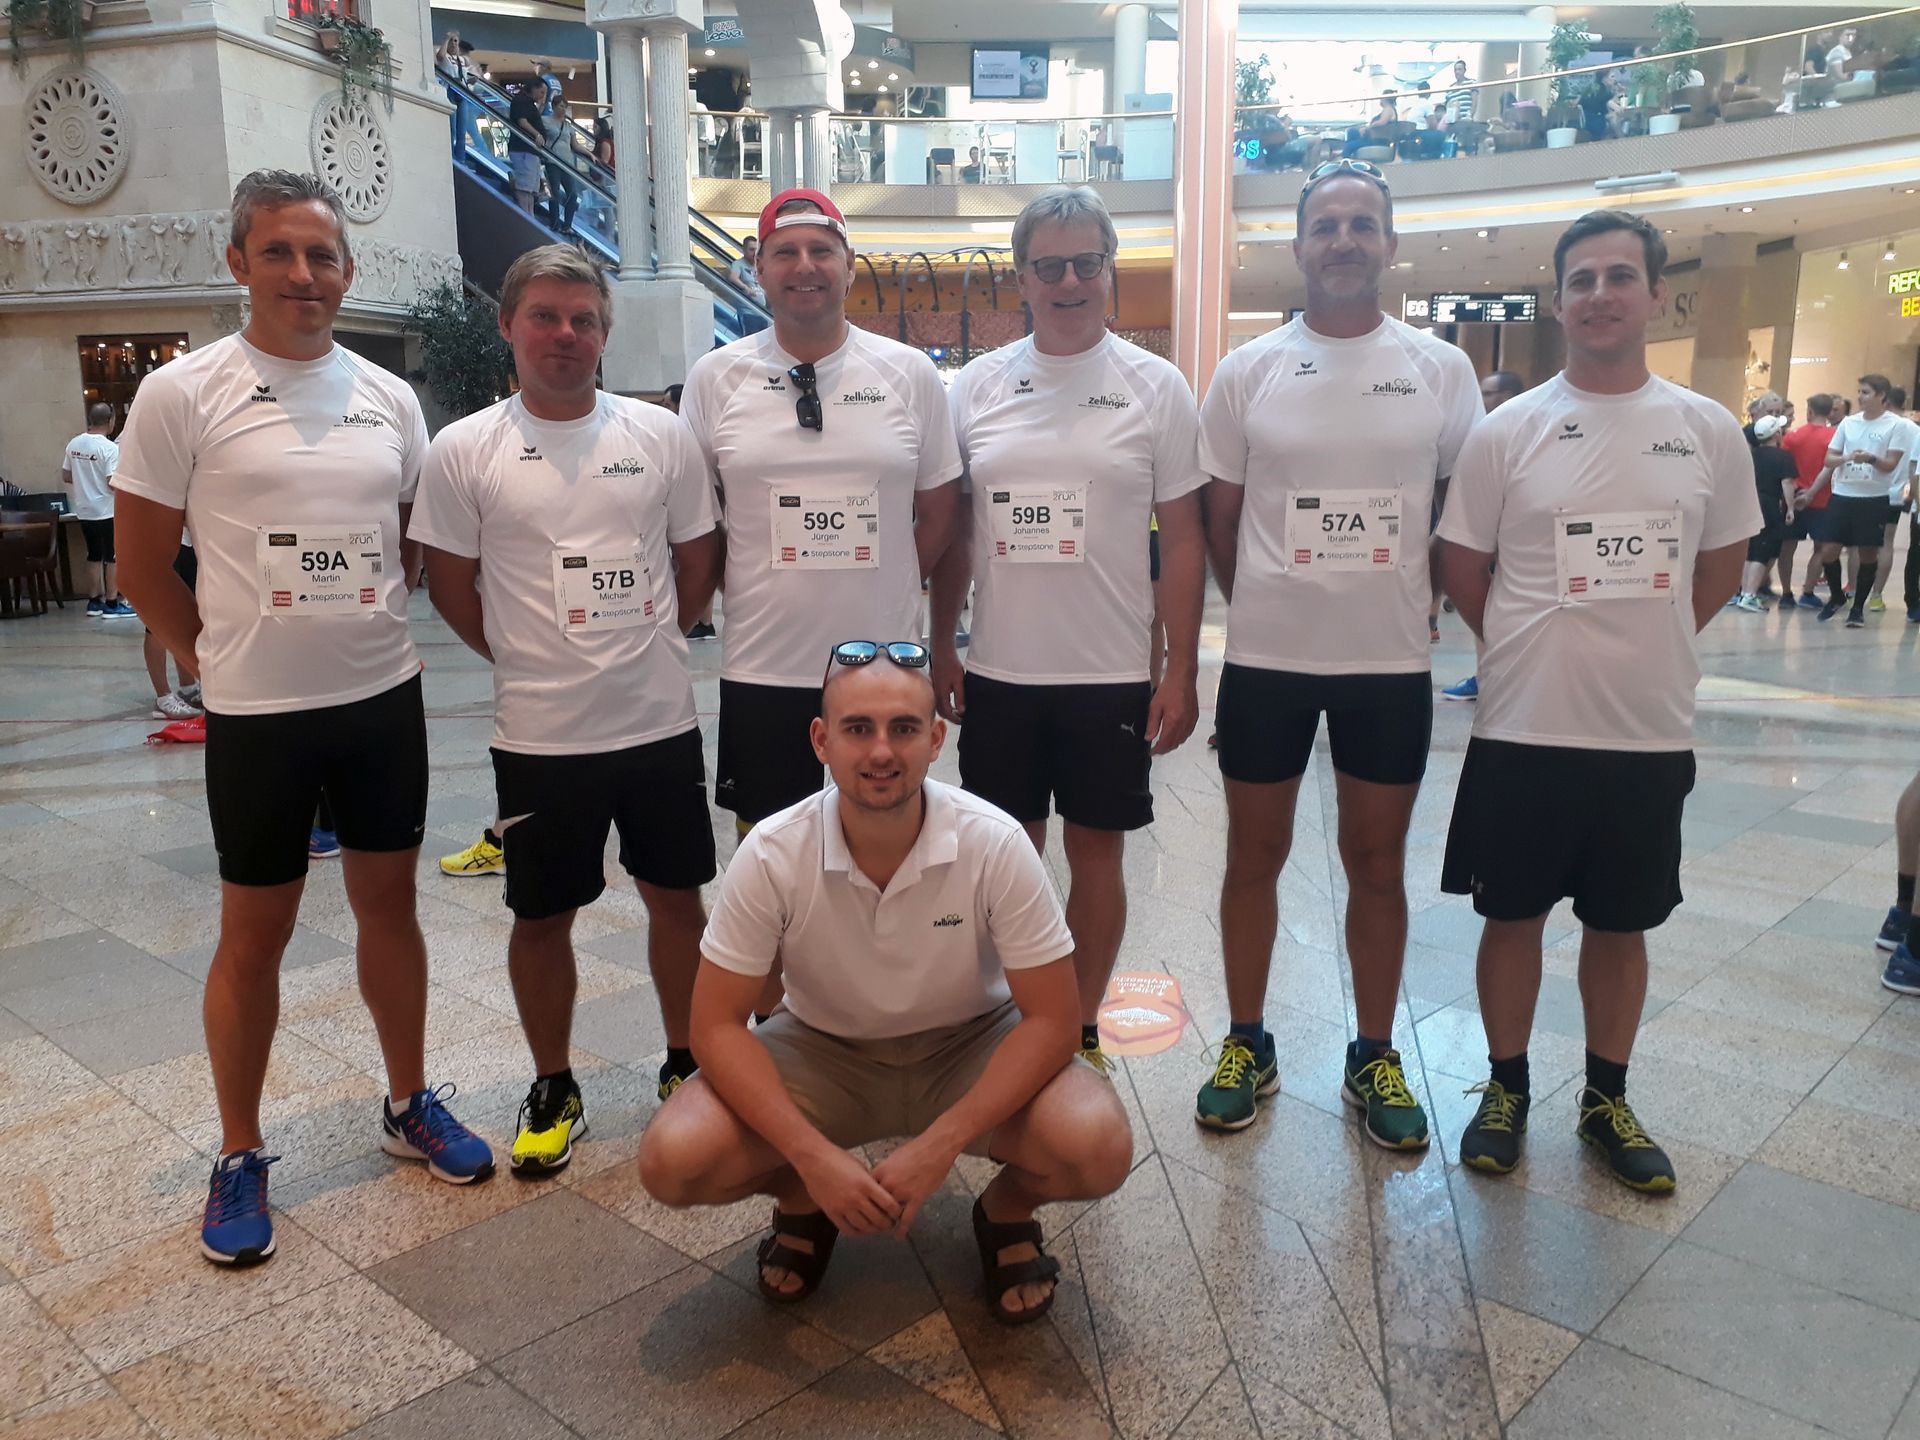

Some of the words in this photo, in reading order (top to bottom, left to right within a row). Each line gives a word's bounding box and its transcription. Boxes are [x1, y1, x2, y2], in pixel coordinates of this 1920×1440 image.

[1372, 382, 1417, 395] Zellinger
[843, 392, 886, 403] Zellinger
[1088, 395, 1131, 409] Zellinger
[342, 413, 384, 427] Zellinger
[1652, 441, 1696, 457] Zellinger
[602, 462, 644, 475] Zellinger
[804, 511, 845, 530] 59C
[1012, 506, 1051, 524] 59B
[1322, 513, 1366, 532] 57A
[811, 533, 840, 542] Jürgen
[1013, 527, 1050, 535] Johannes
[1327, 535, 1360, 543] Ibrahim
[1018, 544, 1054, 552] StepStone
[1597, 536, 1644, 557] 57C
[301, 550, 349, 571] 59A
[811, 550, 850, 558] StepStone
[312, 574, 341, 583] Martin
[592, 569, 636, 591] 57B
[310, 593, 355, 602] StepStone
[599, 591, 632, 601] Michael
[601, 607, 641, 618] StepStone
